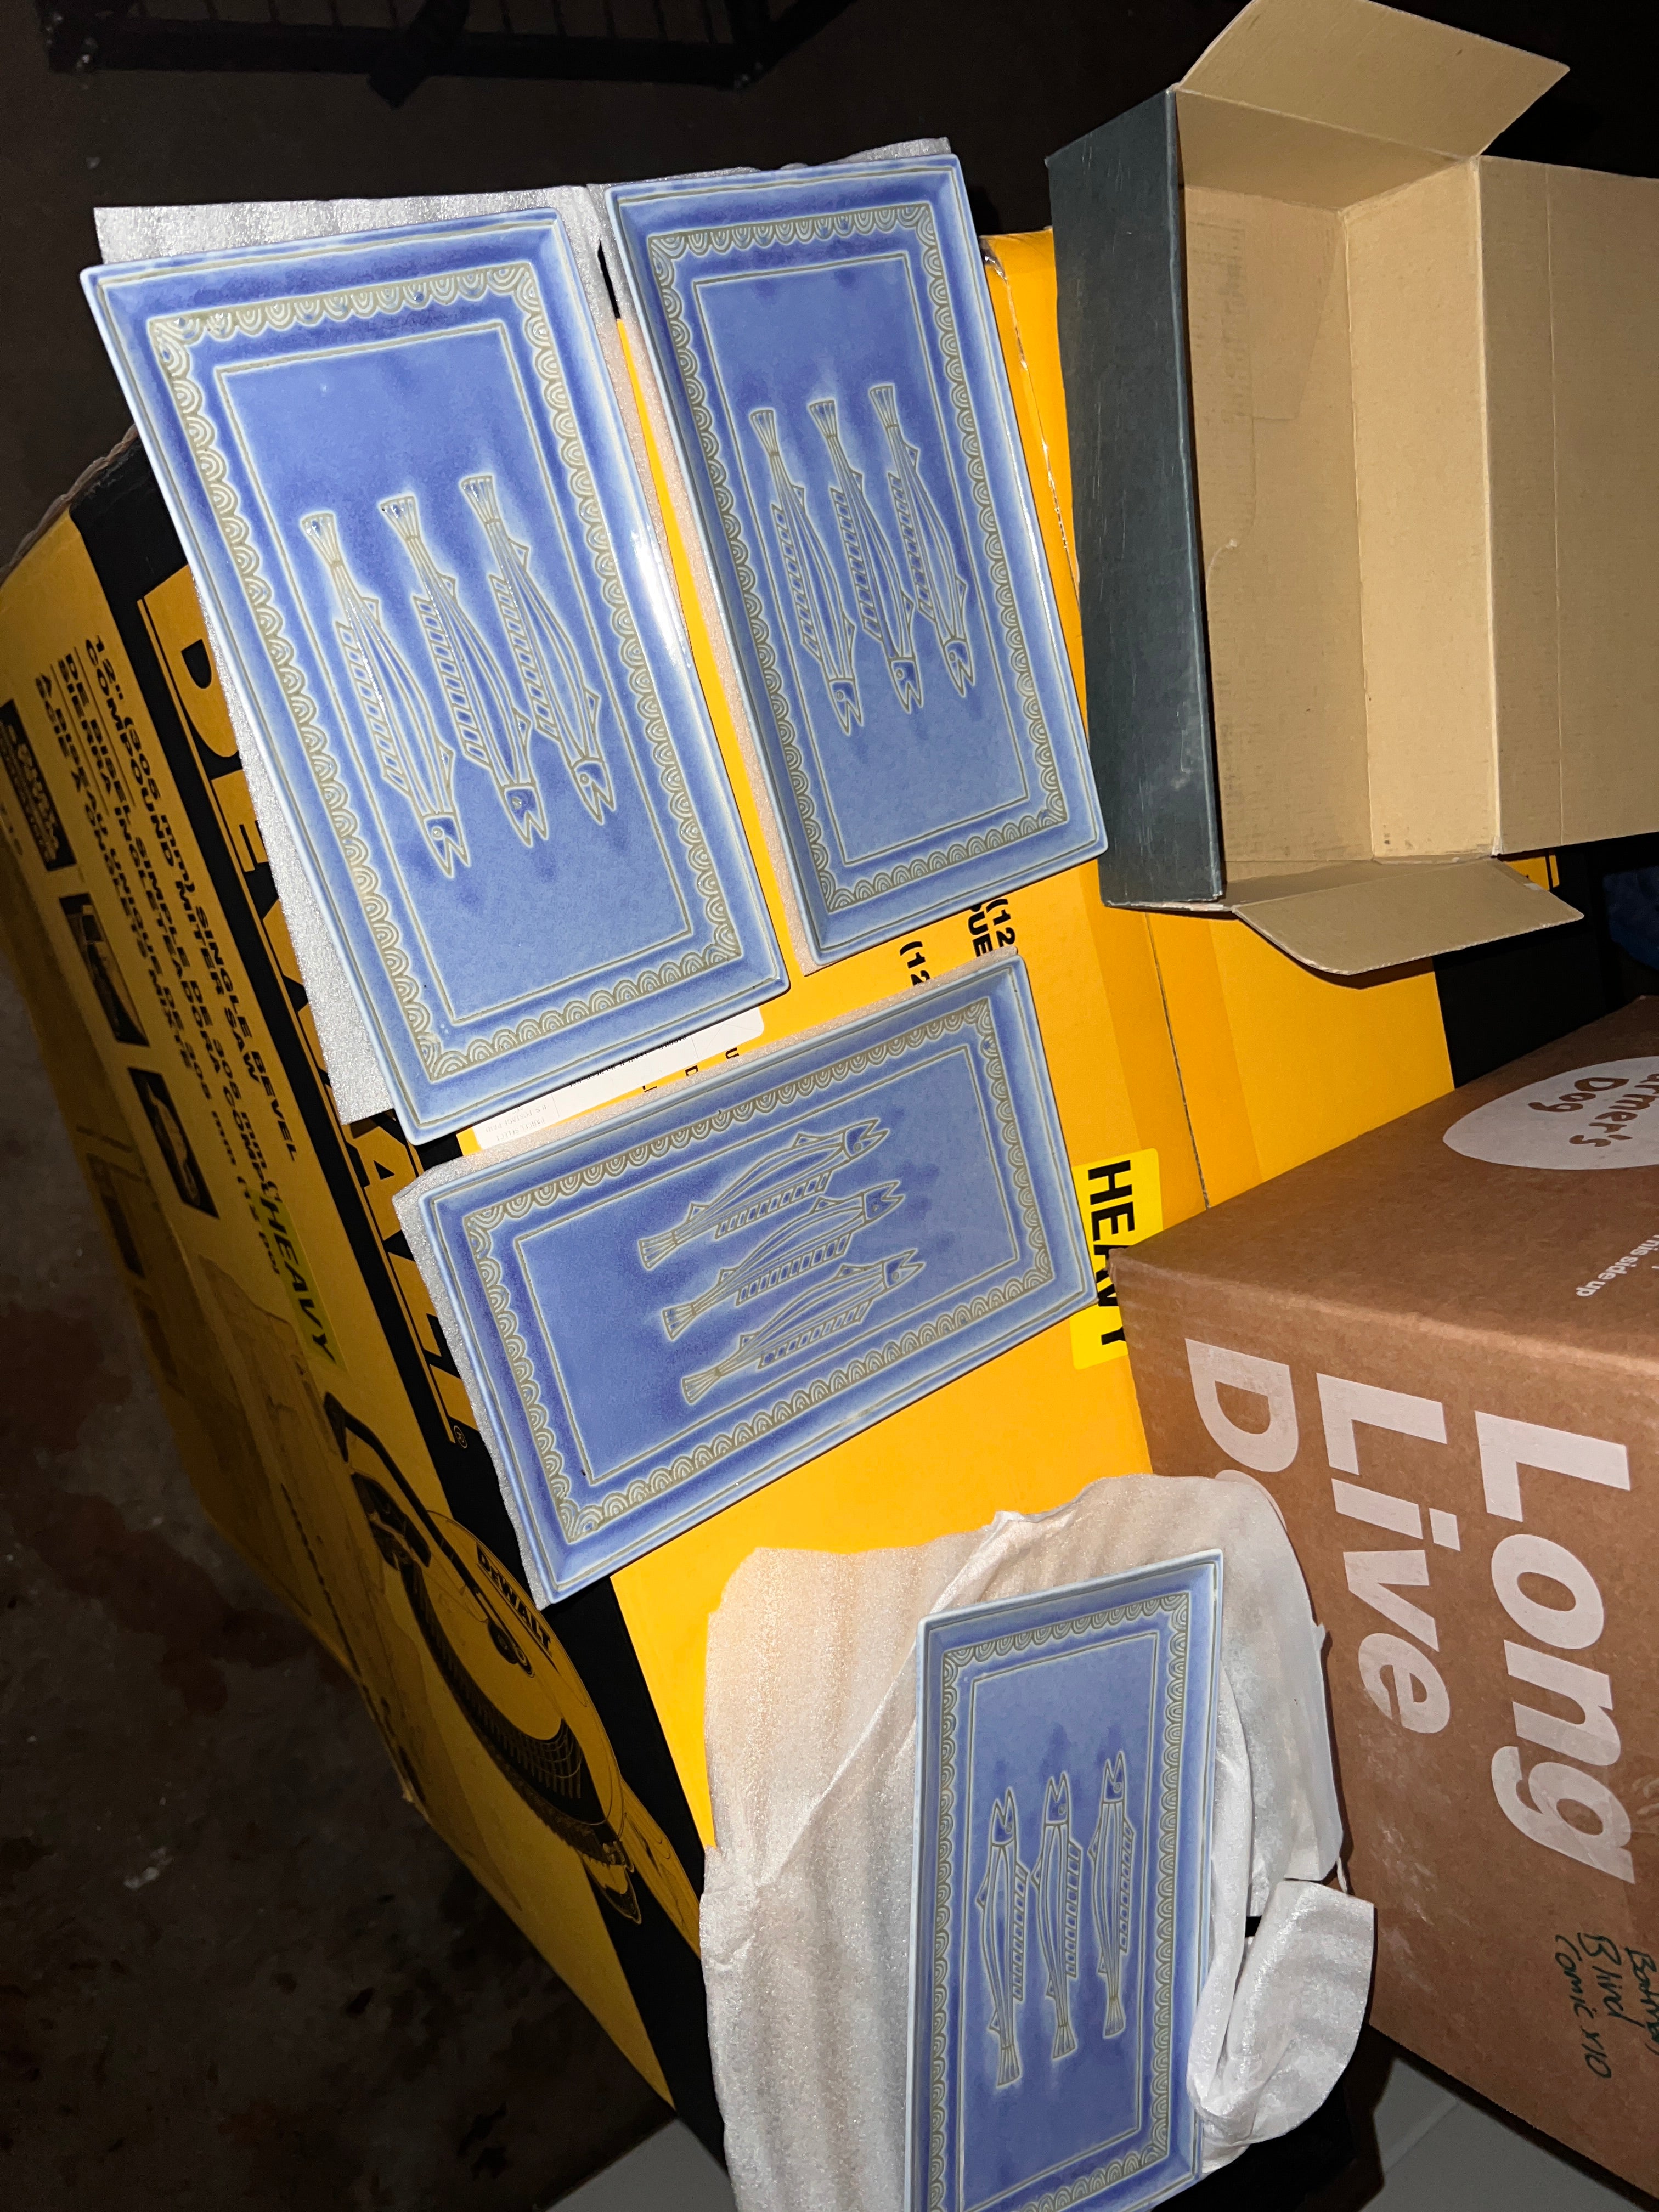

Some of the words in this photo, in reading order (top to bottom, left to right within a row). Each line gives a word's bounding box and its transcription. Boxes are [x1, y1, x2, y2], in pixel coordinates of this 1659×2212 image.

[58, 659, 111, 793] SIERRA
[115, 807, 220, 1073] INGLETEADORA
[65, 654, 89, 705] DE
[91, 720, 131, 824] BISEL
[136, 837, 190, 967] SIMPLE
[190, 980, 212, 1026] DE
[213, 1039, 241, 1100] 305
[241, 1112, 267, 1169] mm
[86, 639, 174, 866] COMPOUND
[176, 881, 222, 994] MITER
[224, 1007, 259, 1082] SAW
[97, 635, 123, 700] 12"
[123, 718, 161, 800] (305
[161, 815, 195, 893] mm)
[196, 906, 252, 1038] SINGLE
[251, 1051, 296, 1161] BEVEL
[986, 899, 1015, 948] (12
[1527, 1077, 1630, 1113] Dog
[1597, 1255, 1639, 1280] side
[260, 1196, 336, 1365] HEAVY
[1575, 1280, 1606, 1298] up
[1317, 1373, 1461, 1734] Live
[1475, 1410, 1635, 1883] Long
